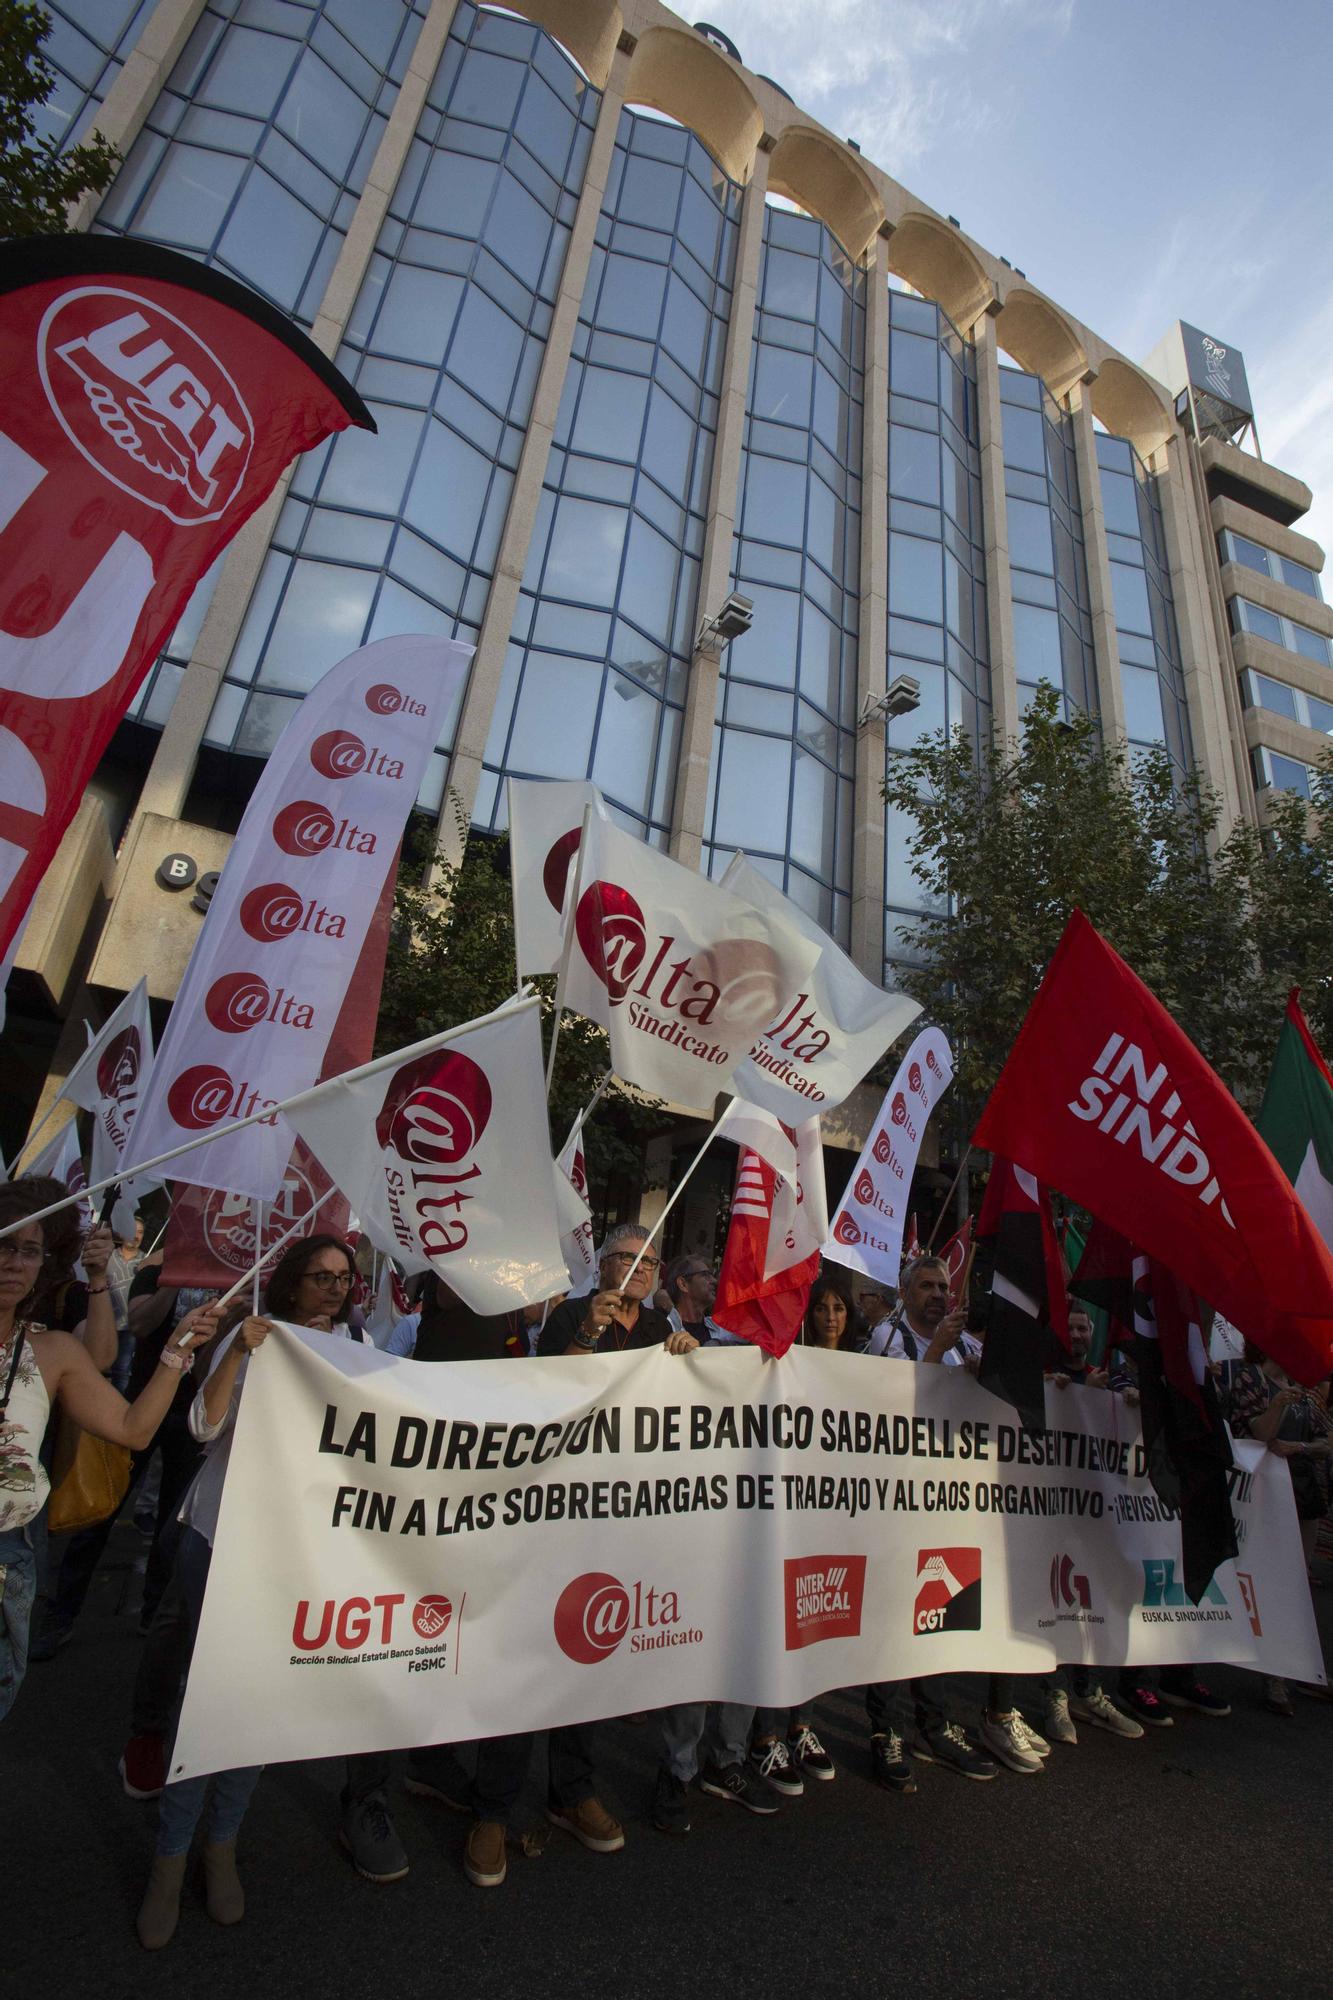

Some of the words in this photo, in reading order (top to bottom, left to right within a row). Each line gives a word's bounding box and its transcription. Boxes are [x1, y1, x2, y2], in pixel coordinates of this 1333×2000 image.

[88, 311, 246, 478] UGT
[628, 1001, 729, 1066] Sindicato
[318, 1403, 376, 1464] LA
[390, 1406, 621, 1470] DIRECCIÓN
[634, 1405, 681, 1454] DE
[690, 1403, 814, 1450] BANCO
[820, 1408, 955, 1459] SABADELL
[959, 1420, 990, 1461] SE
[331, 1485, 397, 1533] FIN
[400, 1498, 426, 1537] A
[435, 1492, 498, 1537] LAS
[735, 1474, 775, 1510] DE
[780, 1474, 871, 1518] TRABAJO
[875, 1478, 889, 1511] Y
[893, 1479, 920, 1512] AL
[923, 1479, 971, 1512] CAOS
[795, 1572, 825, 1598] INTER
[796, 1591, 851, 1620] SINDICAL
[916, 1607, 947, 1632] CGT
[1141, 1611, 1174, 1623] EUSKAL
[1176, 1610, 1233, 1622] SINDIKATUA
[292, 1593, 405, 1651] UGT
[289, 1655, 325, 1665] Sección
[326, 1655, 360, 1665] Sindical
[361, 1650, 389, 1662] Estatal
[390, 1649, 414, 1659] Banco
[414, 1643, 447, 1656] Sabadell
[630, 1626, 703, 1654] Sindicato
[407, 1657, 446, 1673] FeSMC
